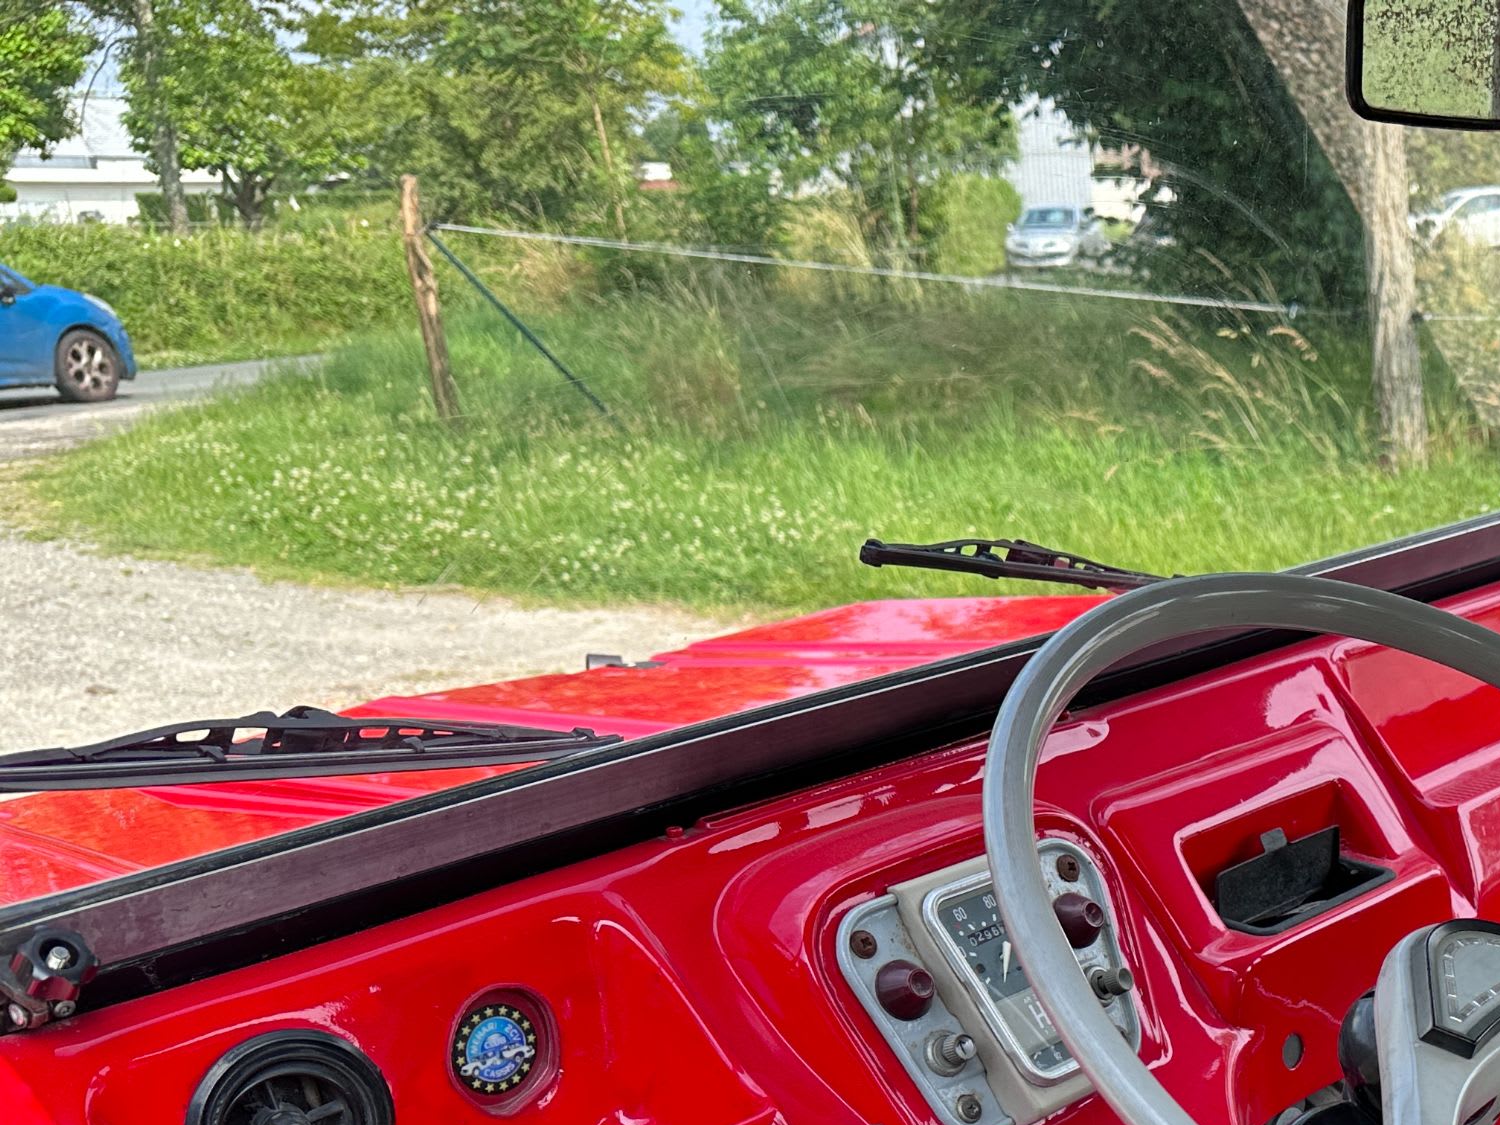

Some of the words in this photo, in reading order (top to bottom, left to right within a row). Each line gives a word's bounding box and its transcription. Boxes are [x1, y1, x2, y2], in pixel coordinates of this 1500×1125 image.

[982, 894, 997, 909] 80
[952, 907, 967, 921] 60
[504, 1023, 521, 1041] 2CV
